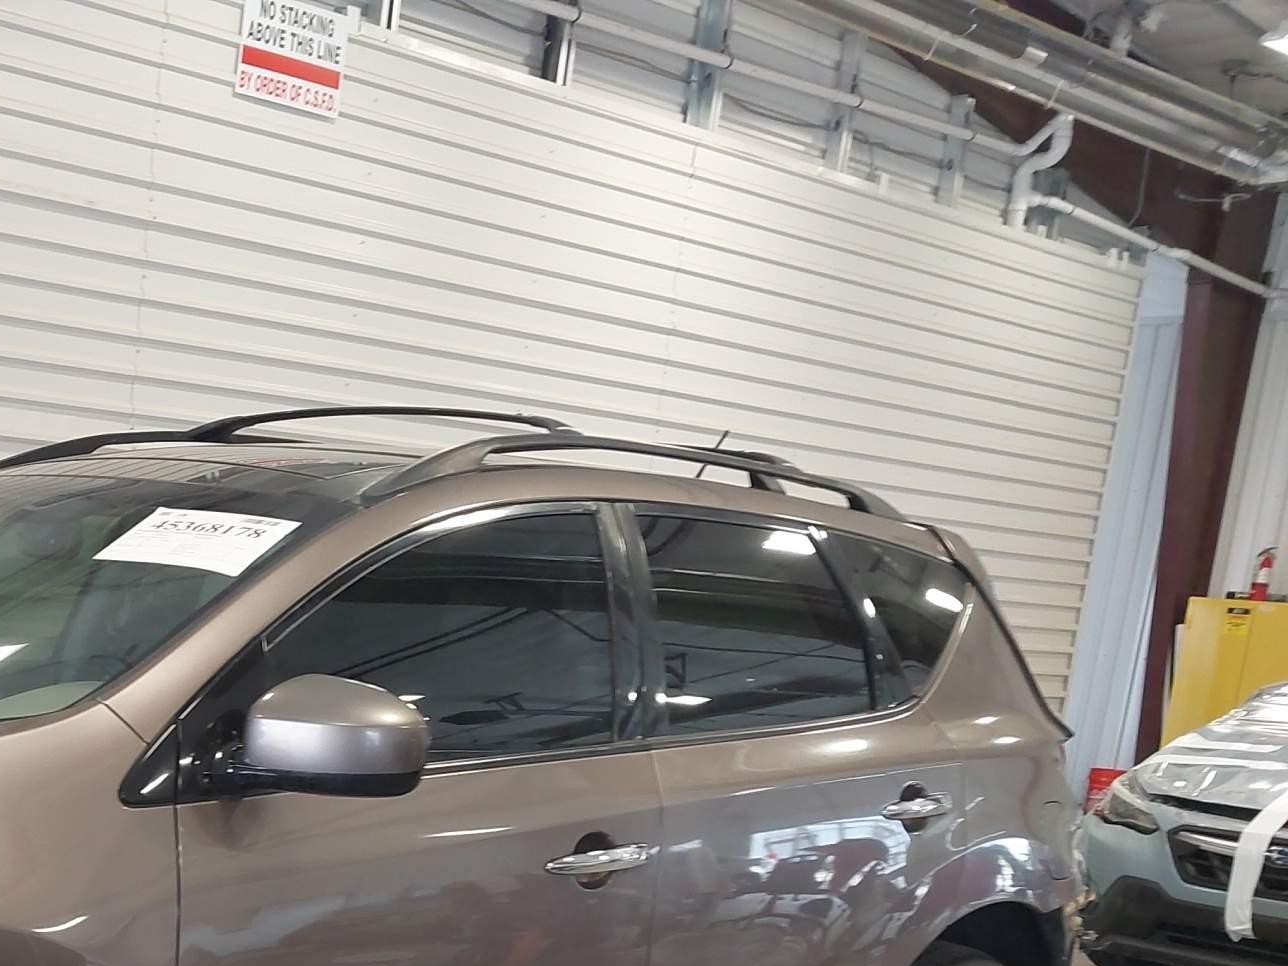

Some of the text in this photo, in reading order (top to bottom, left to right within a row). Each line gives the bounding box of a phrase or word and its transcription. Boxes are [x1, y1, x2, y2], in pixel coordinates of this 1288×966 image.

[260, 0, 335, 38] NO STACKING
[247, 20, 342, 65] ABOVE THIS LINE
[239, 70, 253, 90] BY
[254, 74, 289, 99] ORDER
[290, 84, 303, 102] OF
[152, 520, 267, 539] 45368178
